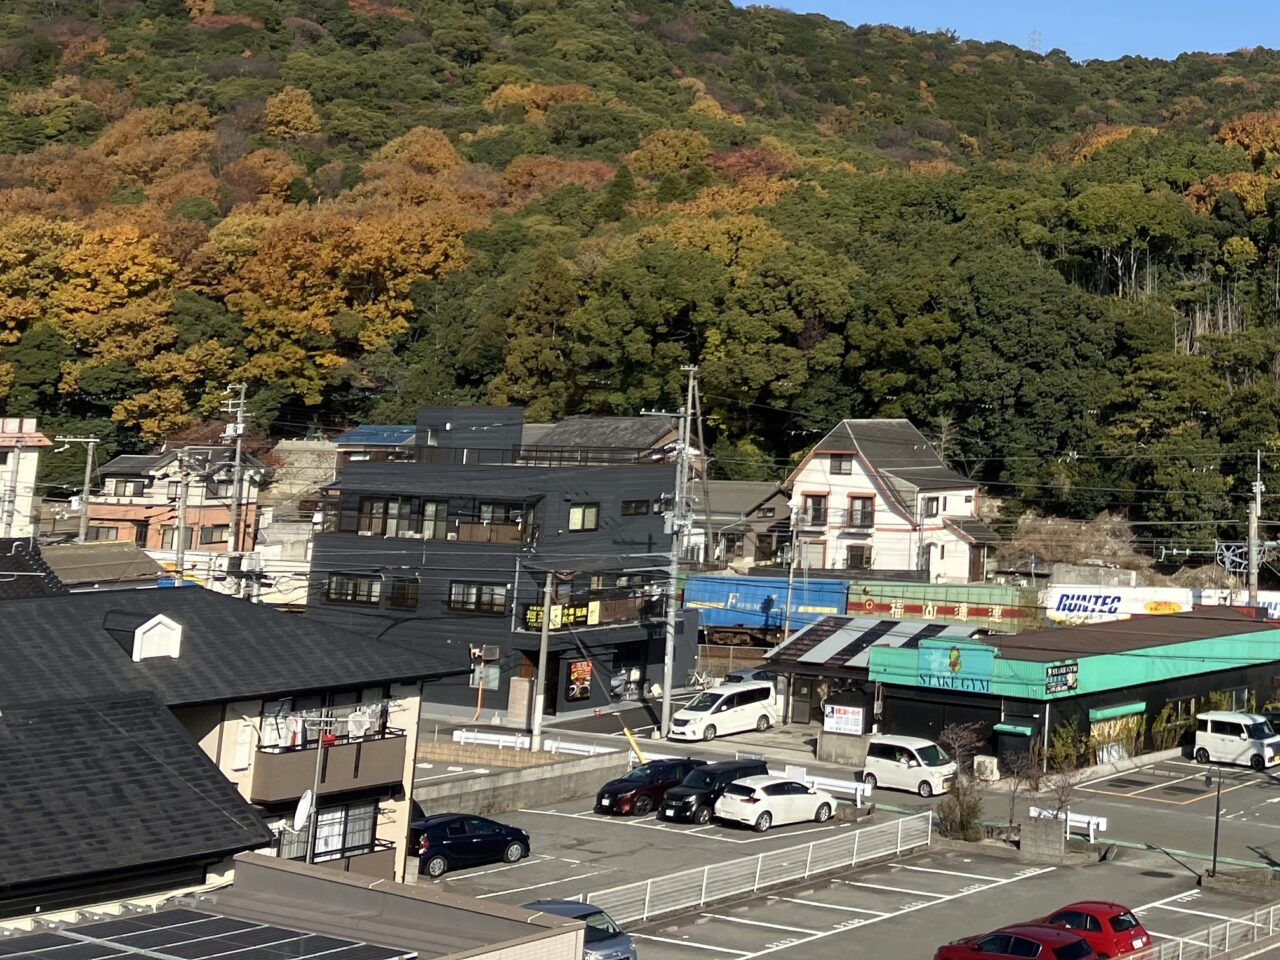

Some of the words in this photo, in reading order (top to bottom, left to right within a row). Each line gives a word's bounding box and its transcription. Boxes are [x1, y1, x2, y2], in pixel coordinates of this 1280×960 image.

[889, 599, 1003, 622] 福山通運
[1056, 594, 1121, 614] RUNTEC
[919, 673, 959, 689] STAKE
[961, 678, 990, 692] GYM
